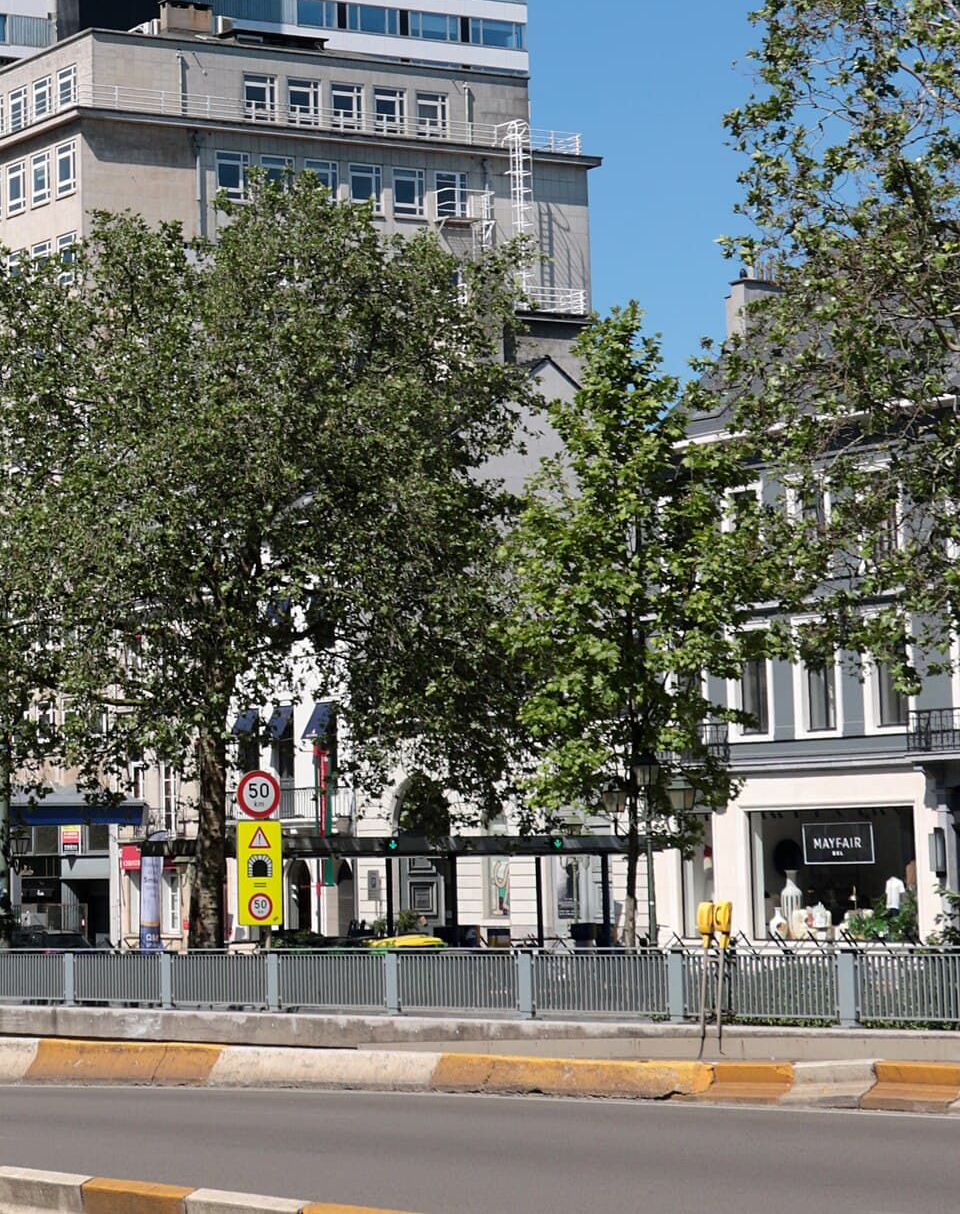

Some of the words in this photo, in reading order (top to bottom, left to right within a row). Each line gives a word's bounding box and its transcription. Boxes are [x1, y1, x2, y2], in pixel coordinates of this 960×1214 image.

[248, 783, 270, 799] 50
[813, 836, 862, 850] MAYFAIR
[254, 899, 267, 909] 50
